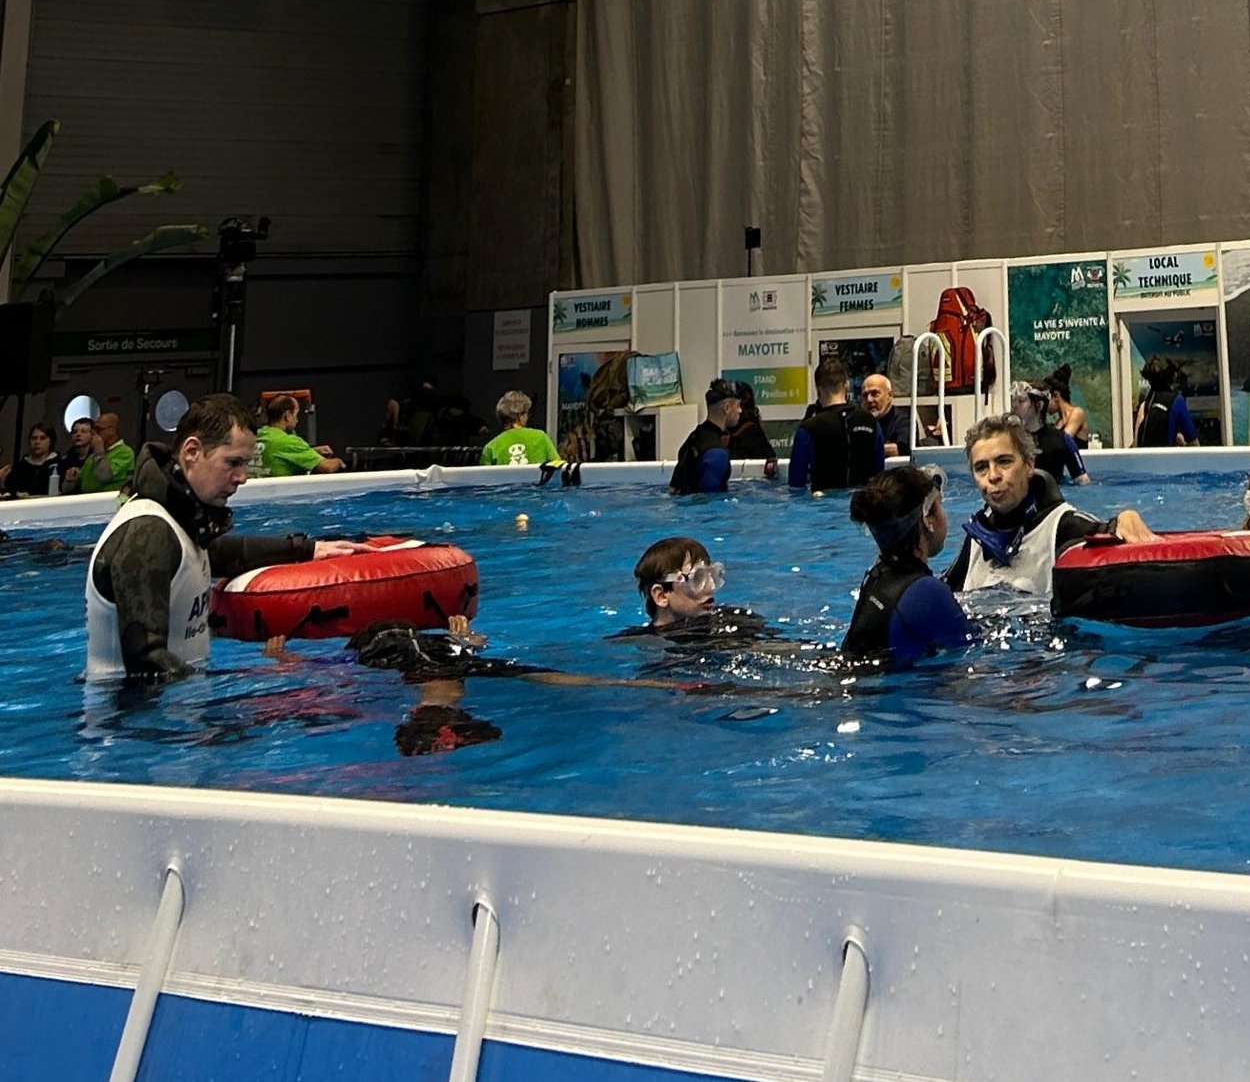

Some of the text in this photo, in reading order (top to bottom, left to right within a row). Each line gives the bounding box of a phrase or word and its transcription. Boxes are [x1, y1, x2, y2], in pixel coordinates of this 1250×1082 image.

[1149, 256, 1179, 269] LOCAL
[1138, 273, 1192, 288] TECHNIQUE
[835, 282, 878, 296] VESTIAIRE
[574, 300, 611, 314] VESTIAIRE
[839, 299, 874, 312] FEMMES
[1034, 320, 1043, 329] LA
[1044, 319, 1057, 328] VIE
[1058, 317, 1098, 328] S'INVENTE
[1034, 331, 1070, 341] MAYOTTE
[88, 337, 178, 351] Sortie de Secours
[738, 342, 789, 356] MAYOTTE
[754, 375, 776, 384] STAND
